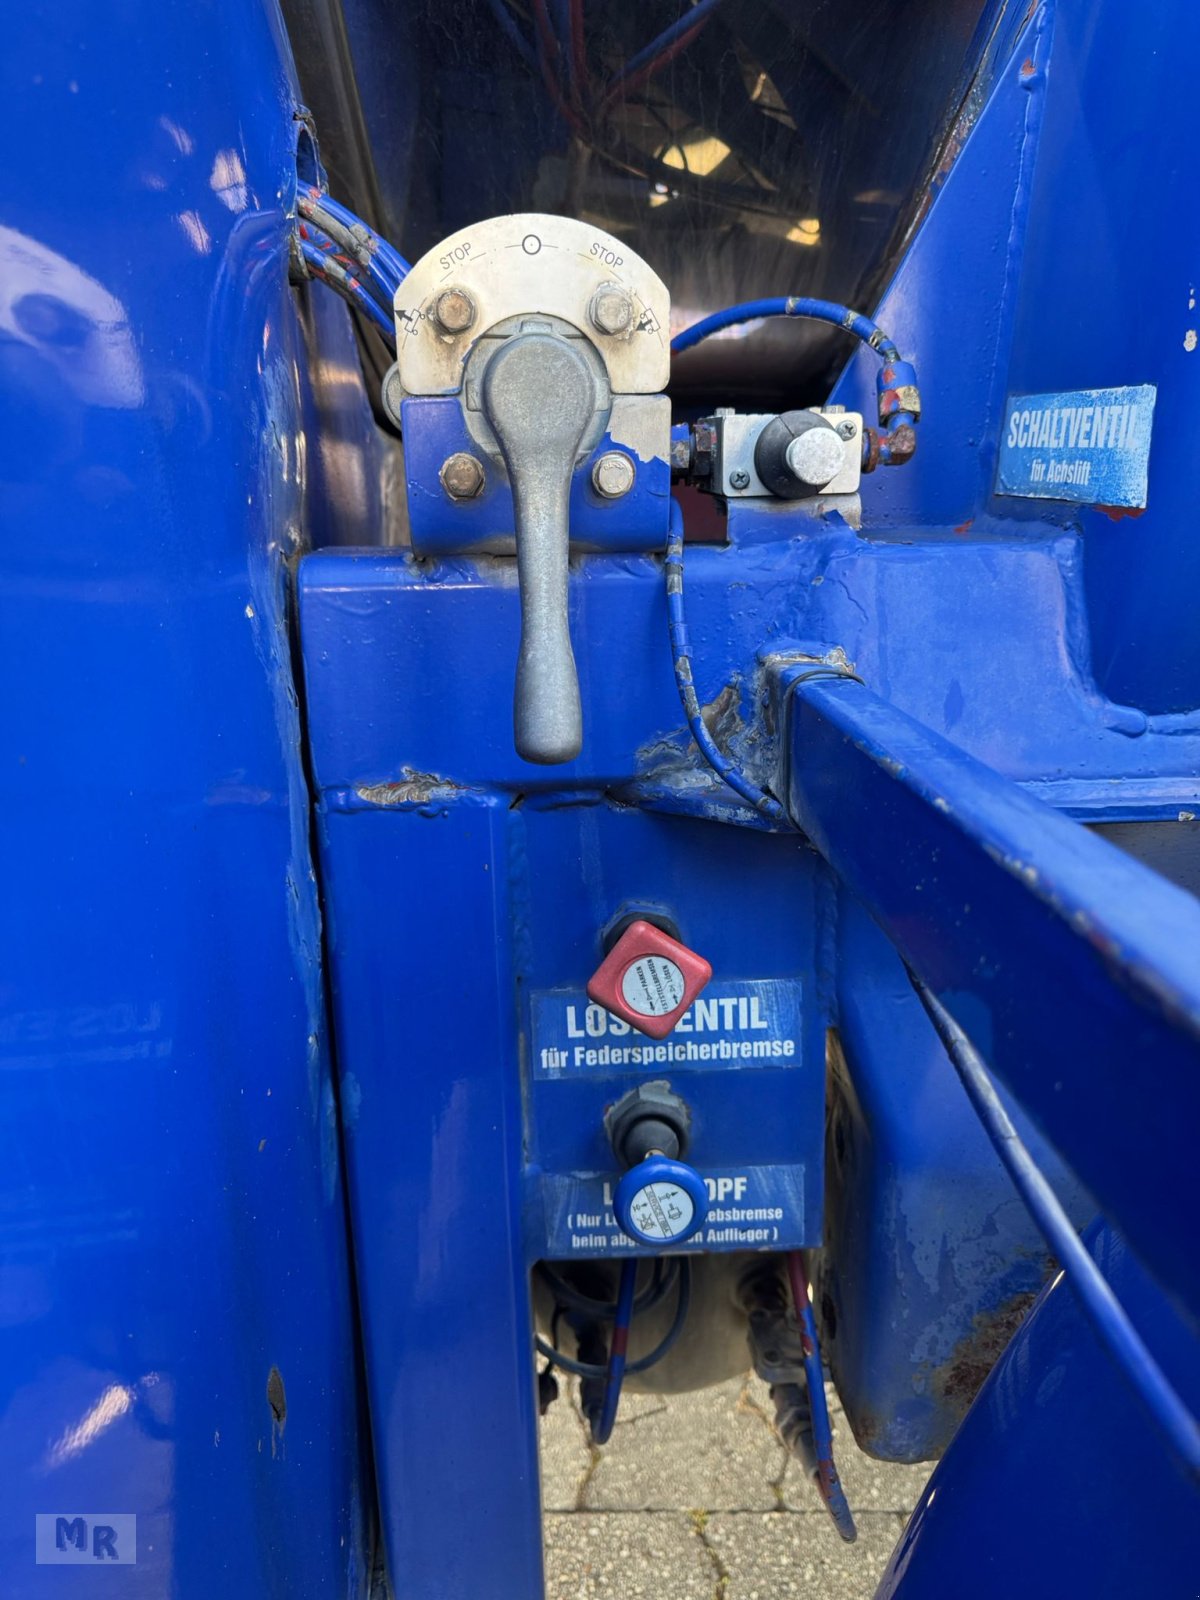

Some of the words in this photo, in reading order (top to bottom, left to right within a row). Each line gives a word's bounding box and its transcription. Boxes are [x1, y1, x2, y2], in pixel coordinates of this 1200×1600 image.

[440, 242, 472, 270] STOP
[589, 243, 624, 268] STOP
[1007, 405, 1138, 448] SCHALTVENTIL
[1030, 459, 1046, 481] für
[1047, 459, 1091, 485] Achslift
[636, 966, 648, 988] PARKEN
[567, 996, 767, 1038] LÖSENTIL
[541, 1049, 568, 1069] für
[574, 1039, 795, 1068] Federspeicherbremse
[576, 1213, 601, 1227] Nur
[572, 1233, 607, 1248] beim
